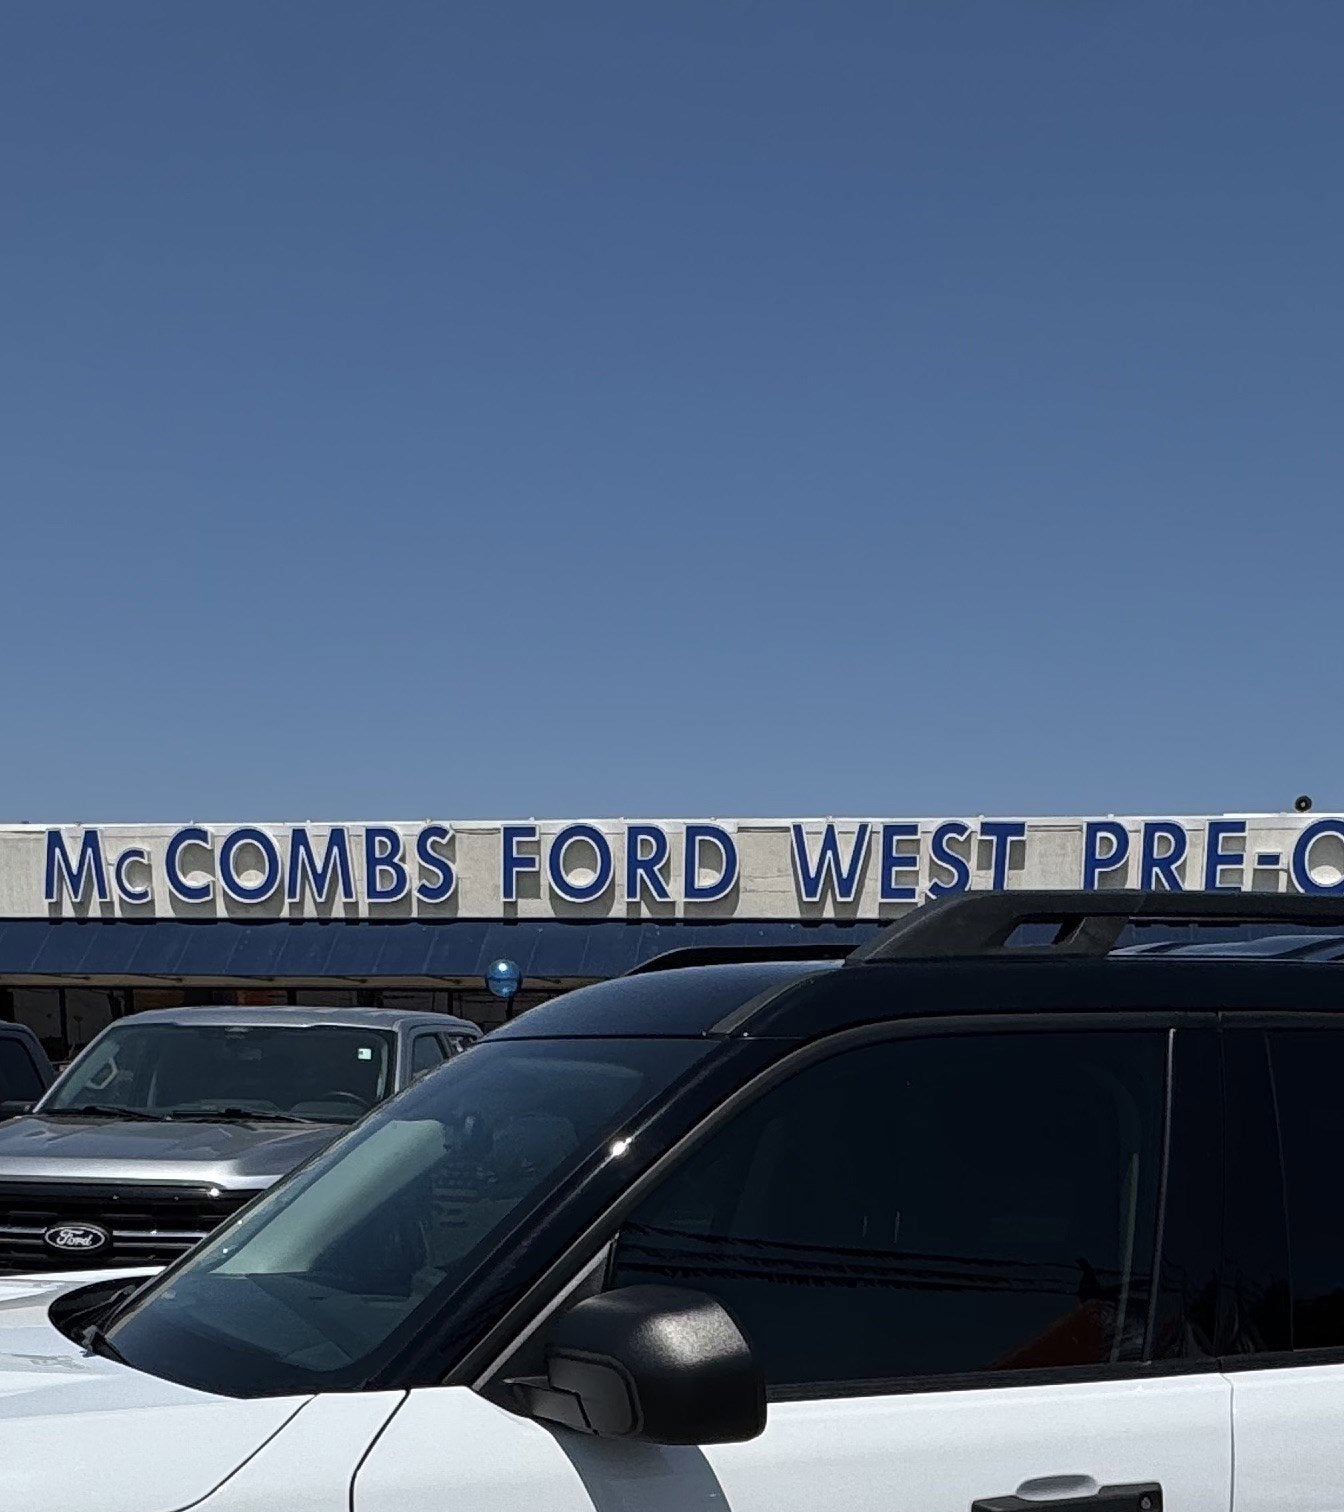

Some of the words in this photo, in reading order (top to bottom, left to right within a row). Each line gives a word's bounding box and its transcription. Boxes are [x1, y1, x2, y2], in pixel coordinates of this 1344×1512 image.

[502, 823, 739, 902] FORD
[791, 820, 1026, 901] WEST
[57, 1228, 93, 1247] Ford
